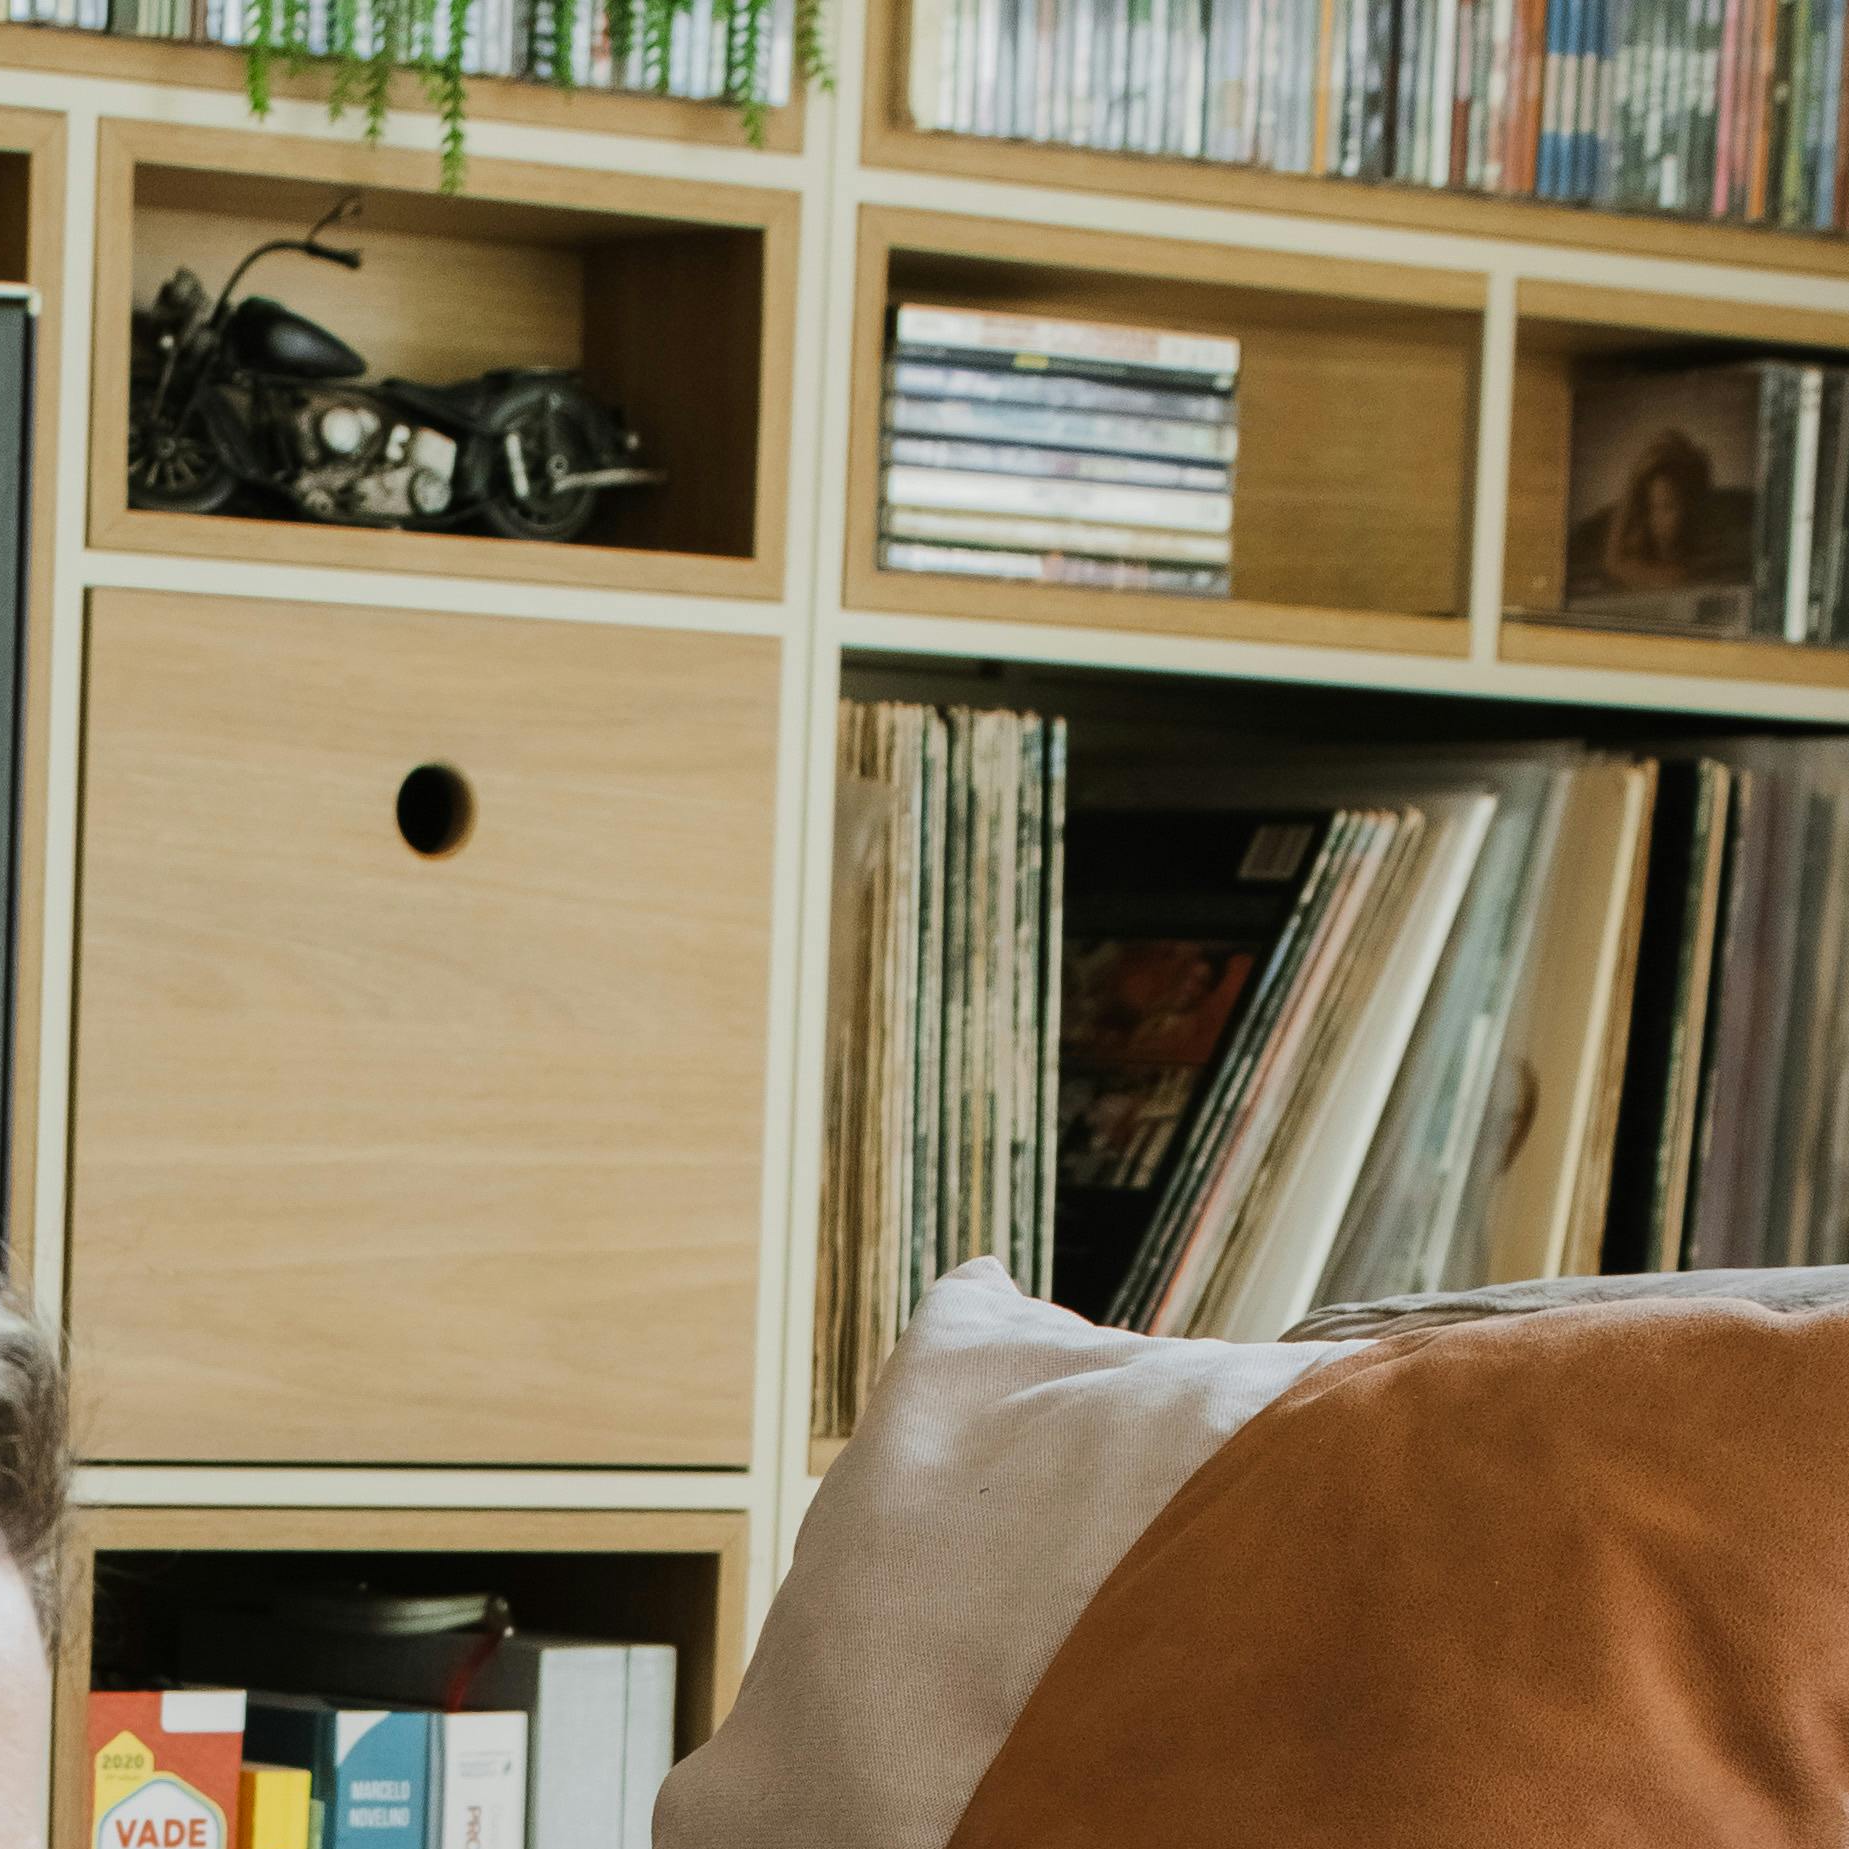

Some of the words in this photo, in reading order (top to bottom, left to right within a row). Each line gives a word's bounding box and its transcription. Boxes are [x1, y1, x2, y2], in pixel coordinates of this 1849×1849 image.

[102, 1753, 144, 1770] 2020
[349, 1779, 411, 1802] MARCELO
[347, 1806, 411, 1829] NOVELINO
[115, 1818, 207, 1848] VADE
